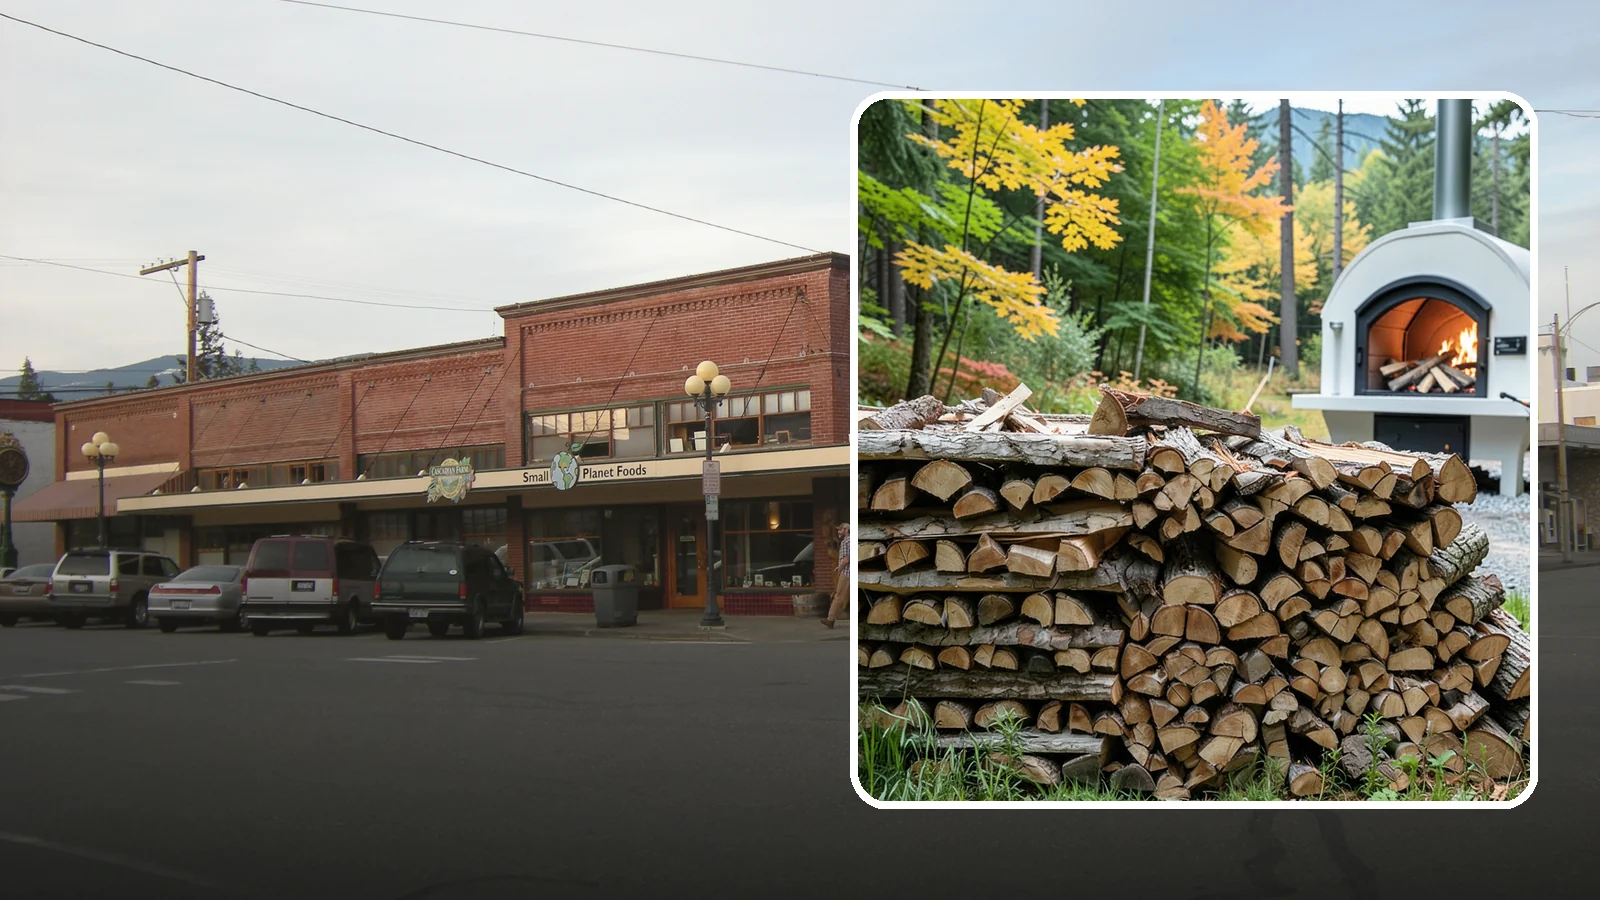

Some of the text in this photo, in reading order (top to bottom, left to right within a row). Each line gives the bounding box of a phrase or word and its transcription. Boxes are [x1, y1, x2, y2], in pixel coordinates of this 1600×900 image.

[523, 464, 647, 483] Small Planet Foods
